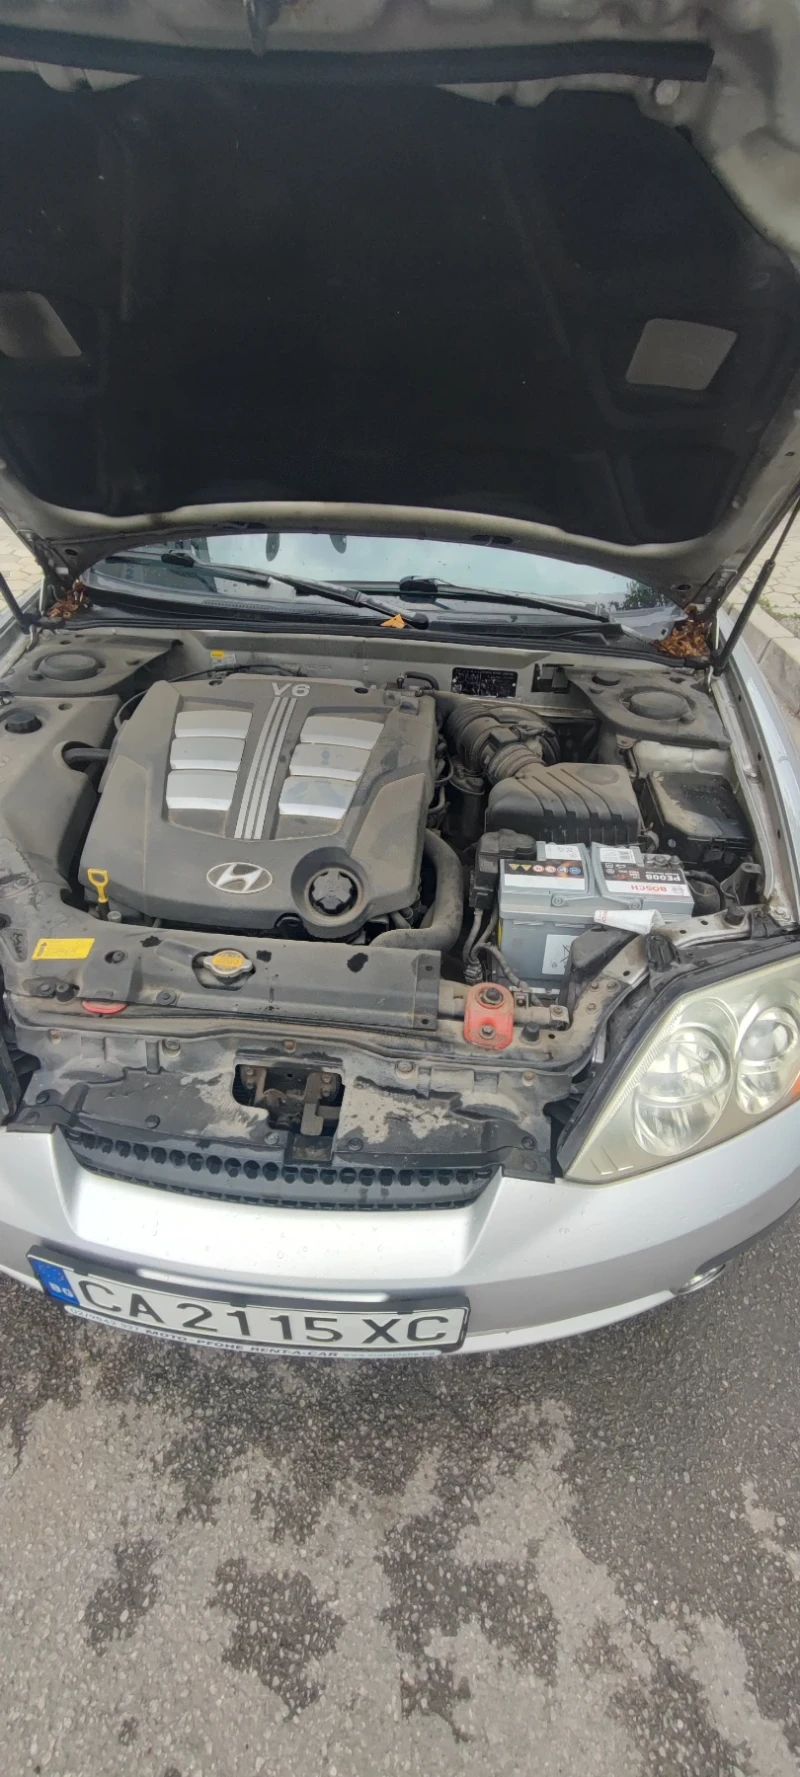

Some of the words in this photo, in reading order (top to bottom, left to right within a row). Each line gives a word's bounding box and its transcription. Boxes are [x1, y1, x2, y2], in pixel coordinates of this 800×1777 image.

[271, 682, 311, 697] V6
[630, 884, 668, 893] BOSCH
[48, 1281, 75, 1298] BG
[78, 1280, 166, 1324] CA
[176, 1302, 343, 1343] 2115
[361, 1315, 449, 1344] XC
